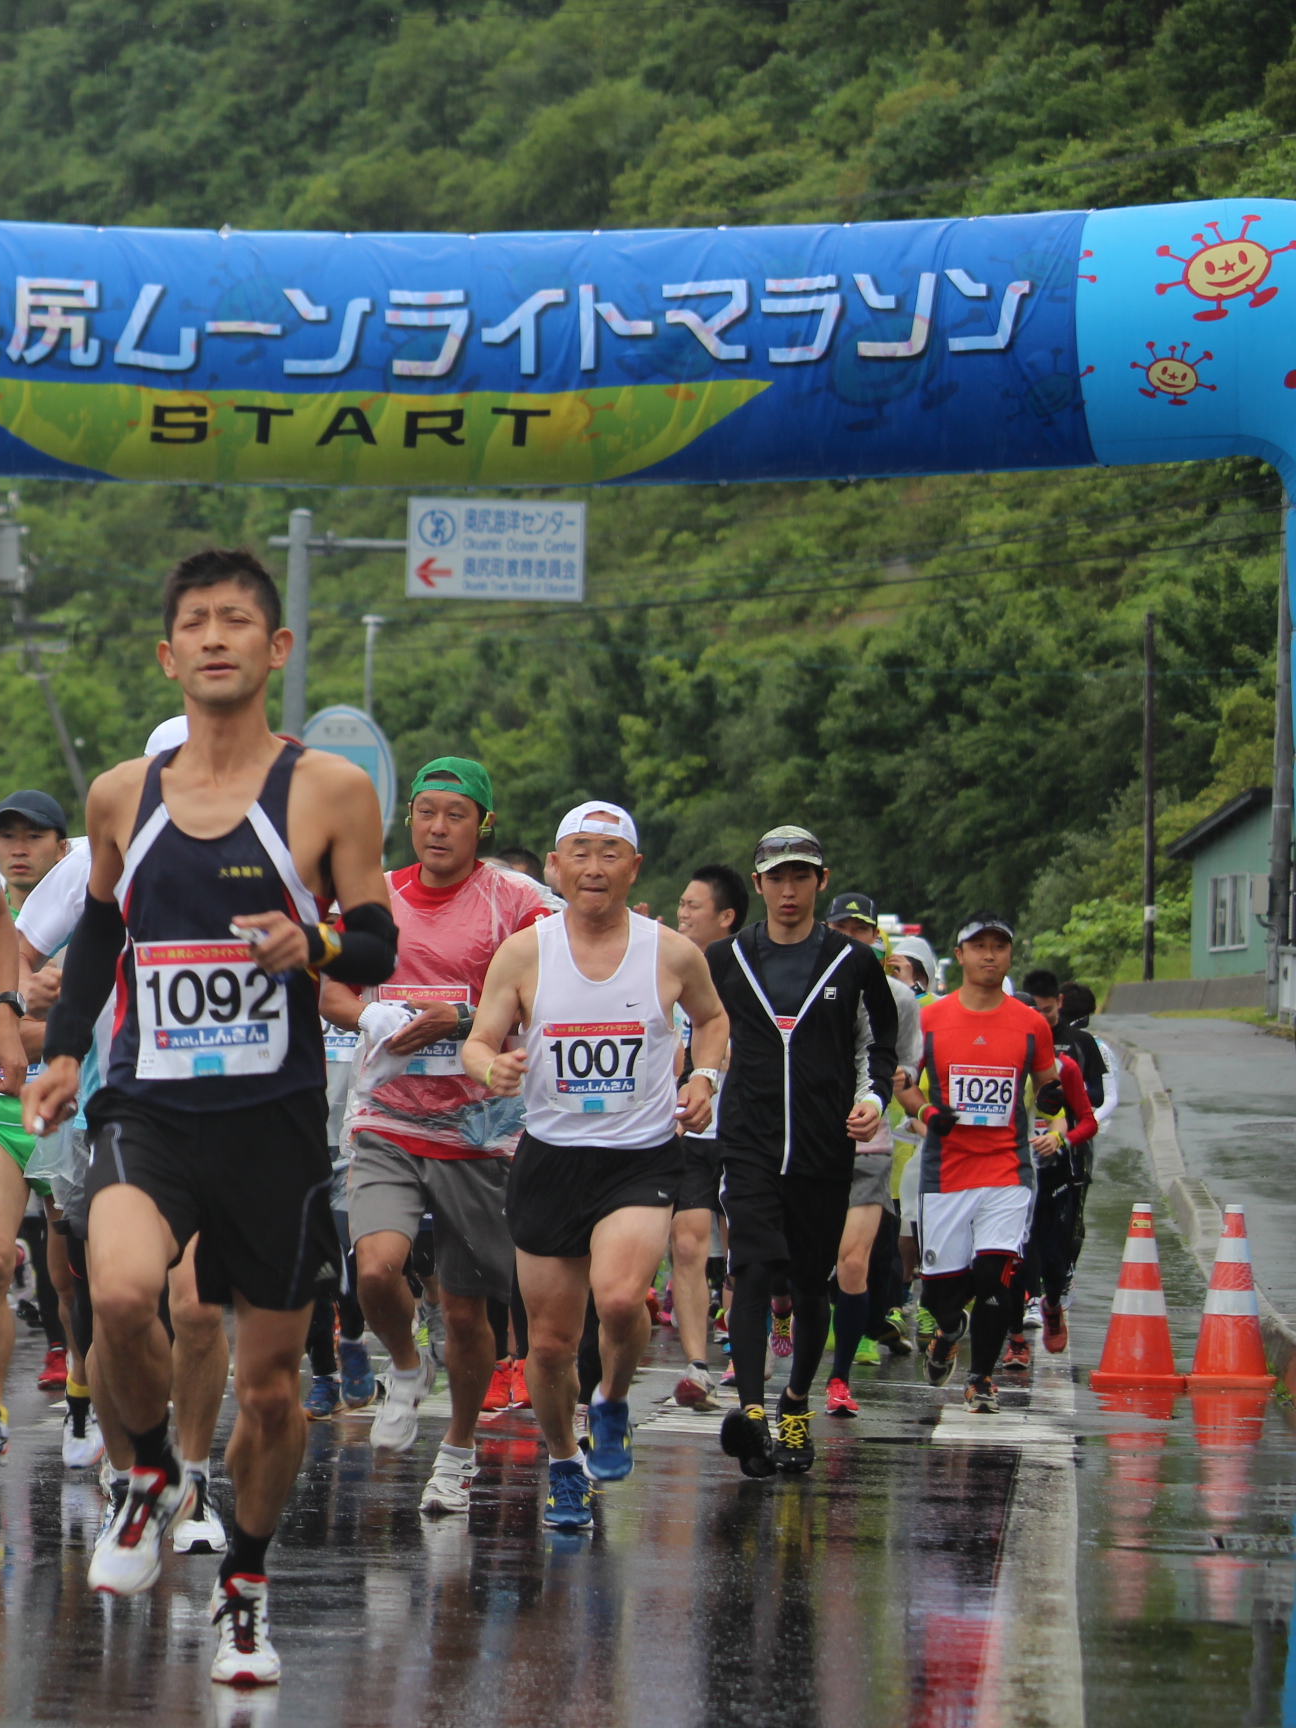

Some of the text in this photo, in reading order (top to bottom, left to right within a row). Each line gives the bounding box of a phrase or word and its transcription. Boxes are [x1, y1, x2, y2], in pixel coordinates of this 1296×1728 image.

[149, 404, 552, 449] START
[146, 968, 280, 1027] 1092
[550, 1037, 643, 1078] 1007
[954, 1077, 1013, 1105] 1026
